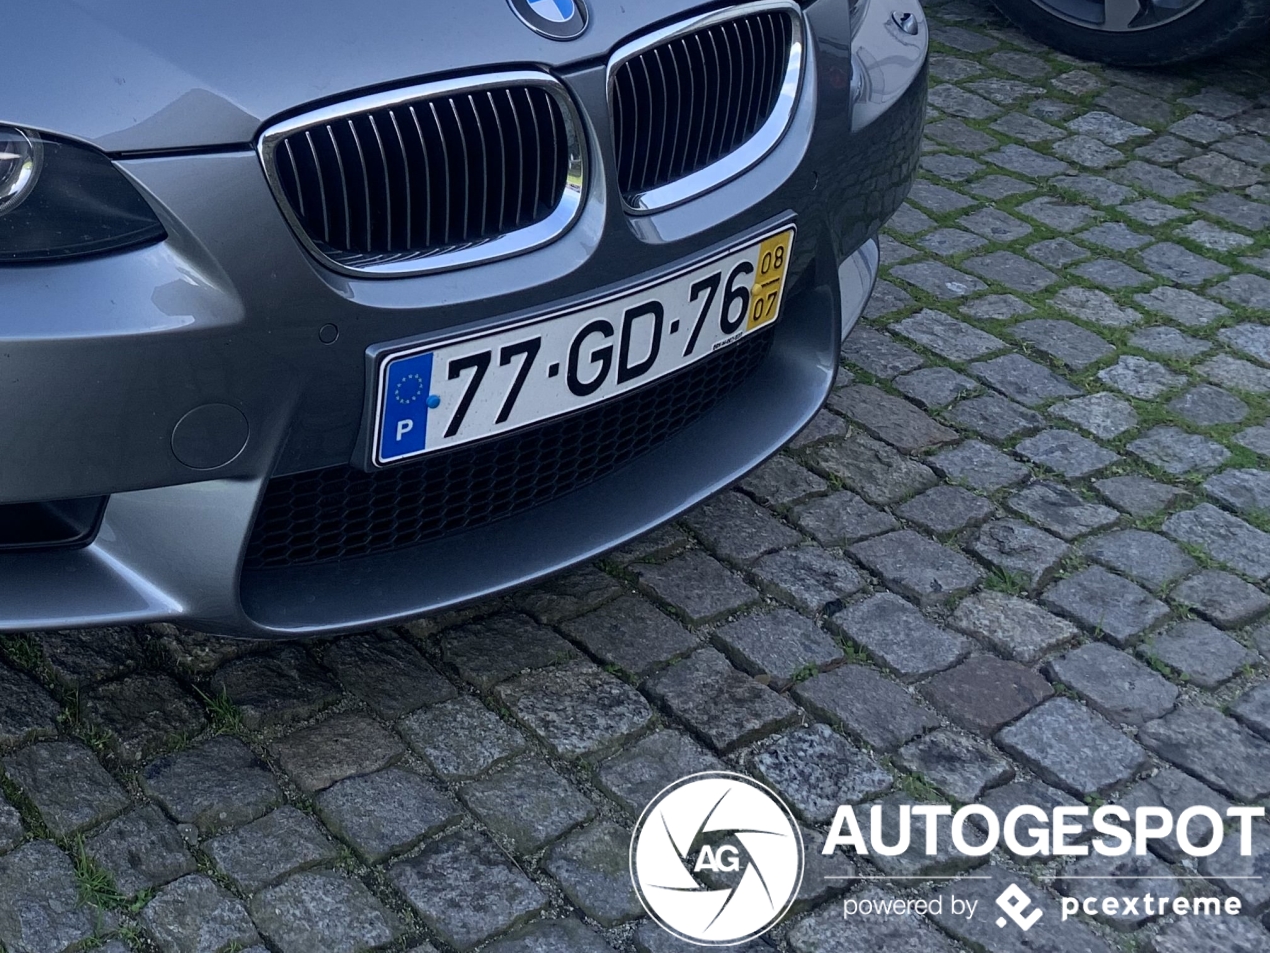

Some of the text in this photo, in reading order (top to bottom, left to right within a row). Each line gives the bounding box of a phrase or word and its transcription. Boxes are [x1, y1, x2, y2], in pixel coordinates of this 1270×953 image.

[760, 245, 785, 276] 08
[751, 291, 778, 322] 07
[395, 419, 414, 442] P
